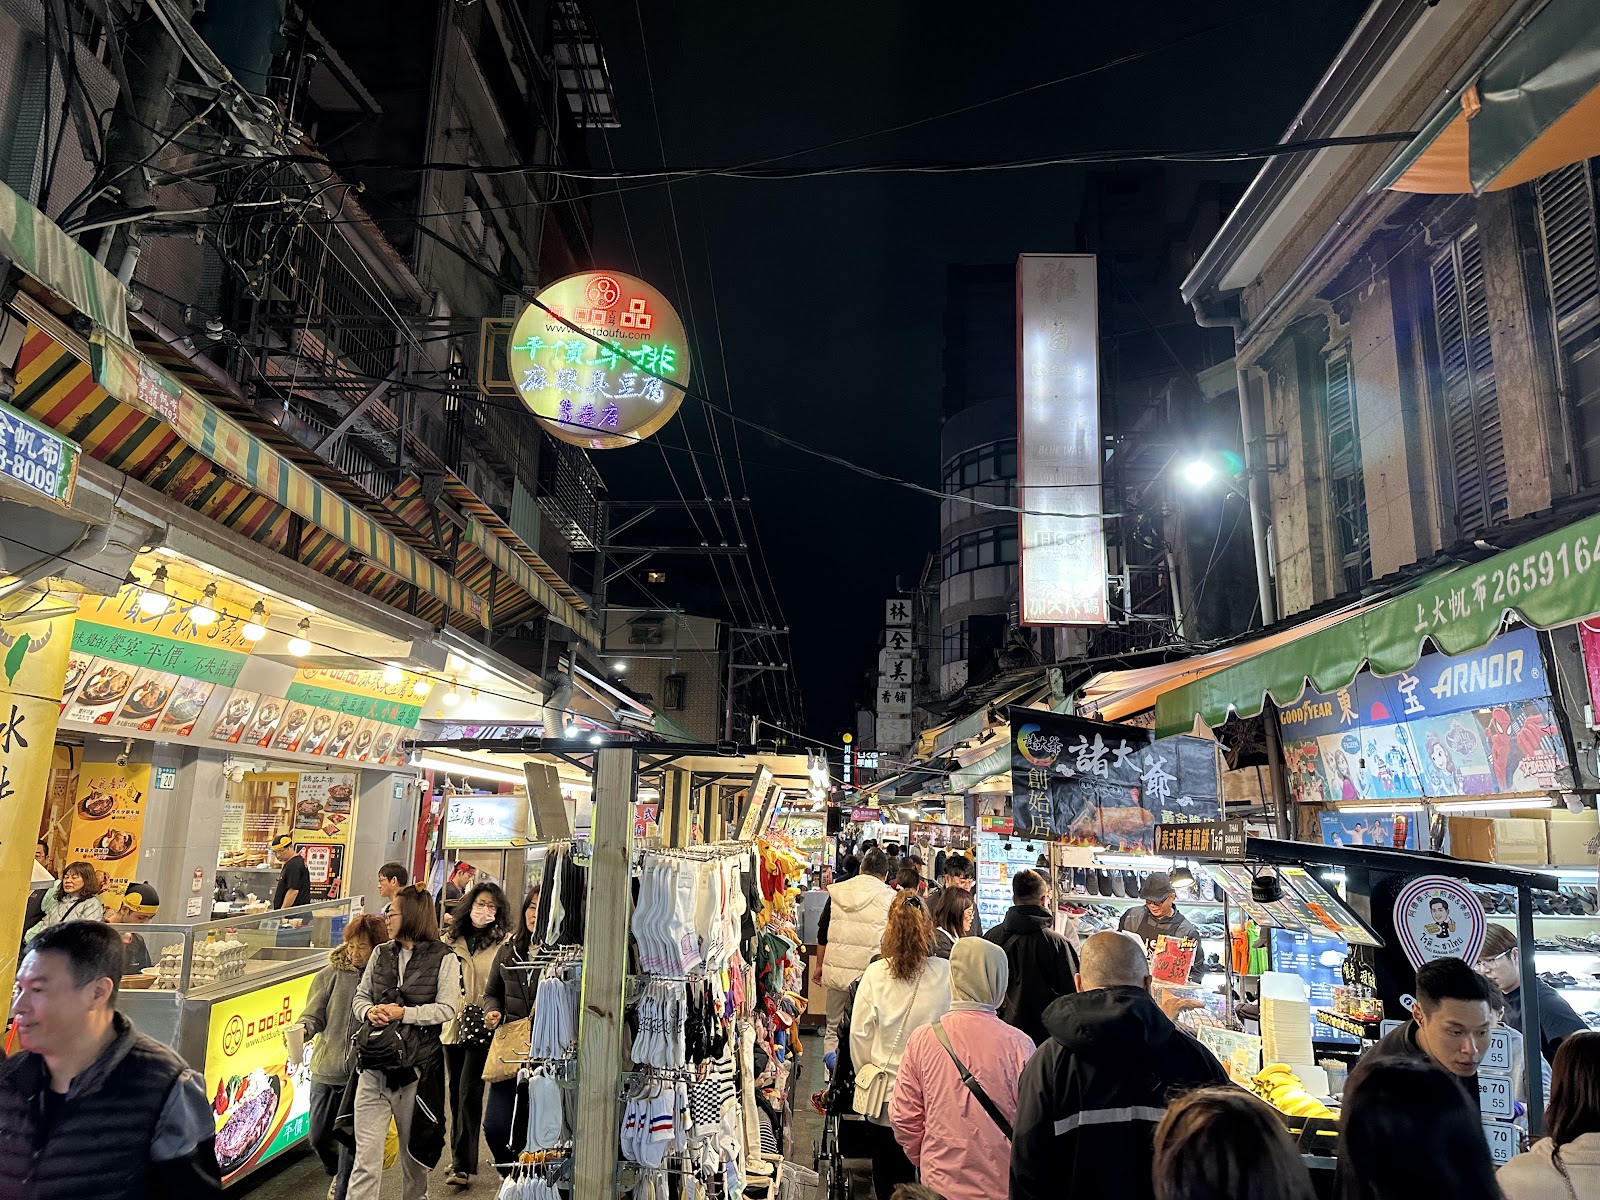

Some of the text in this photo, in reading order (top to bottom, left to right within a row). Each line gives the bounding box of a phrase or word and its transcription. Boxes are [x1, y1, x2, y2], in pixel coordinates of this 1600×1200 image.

[545, 324, 651, 340] wwwhotdoufu.com
[513, 335, 676, 374] 平價牛排
[519, 364, 664, 403] 麻辣臭豆腐
[138, 391, 178, 424] 2336-6792
[1413, 574, 1487, 633] 上大帆布
[889, 601, 910, 682] 林全美
[1280, 699, 1333, 726] GOODYEAR
[1429, 649, 1524, 700] ARNOR
[1069, 732, 1177, 806] 諸大爺
[163, 775, 173, 787] 20
[1028, 767, 1051, 838] 創始店
[448, 803, 475, 826] 豆腐
[1229, 824, 1239, 833] THAI
[1161, 828, 1210, 852] 泰式香蕉煎餅
[1225, 834, 1242, 843] BANANA
[1225, 845, 1240, 855] ROTEE
[1490, 1038, 1503, 1049] 70
[1491, 1052, 1503, 1062] 55
[1491, 1083, 1505, 1094] 70
[1492, 1098, 1504, 1108] 55
[1493, 1130, 1507, 1142] 70
[1494, 1148, 1507, 1158] 55
